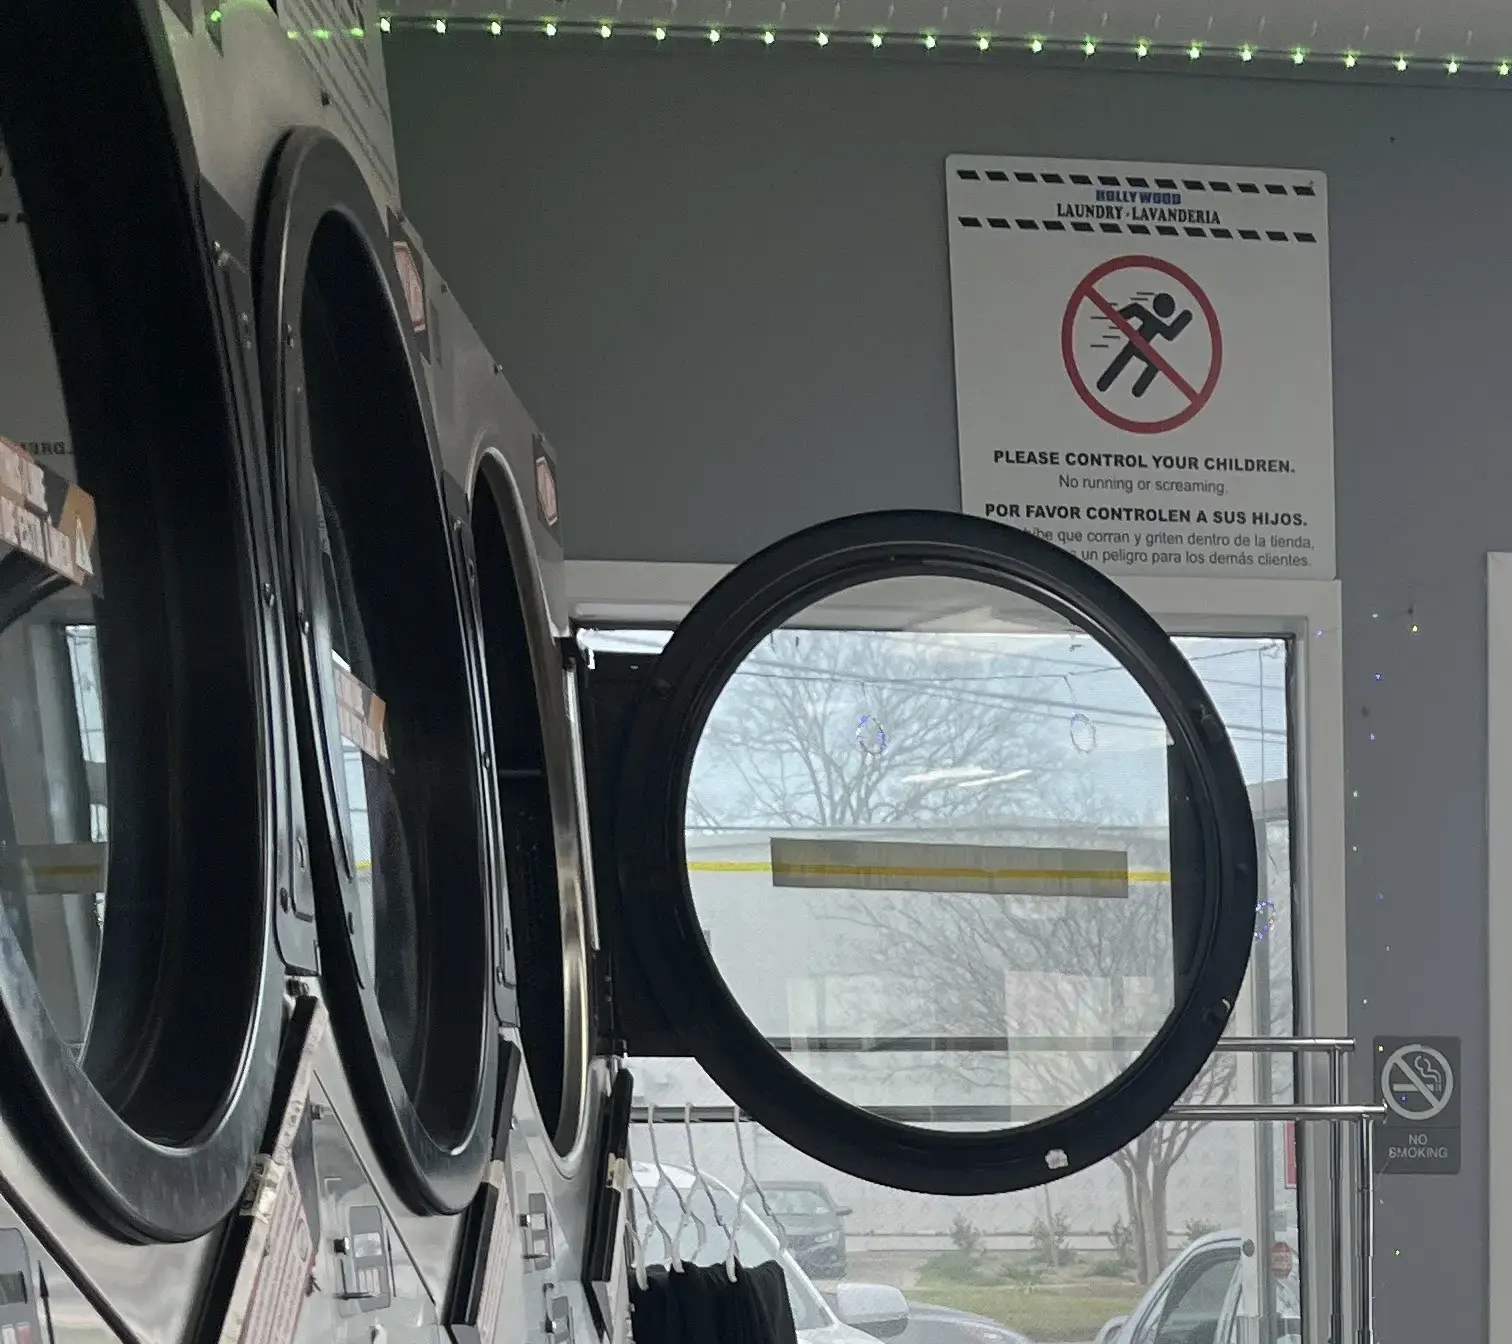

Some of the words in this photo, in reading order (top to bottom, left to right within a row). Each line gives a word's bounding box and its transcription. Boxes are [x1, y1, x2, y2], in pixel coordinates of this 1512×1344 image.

[1096, 190, 1182, 205] HOLLYWOOD
[1057, 203, 1123, 219] LAUNDRY
[1132, 208, 1221, 224] LAVANDERIA
[994, 450, 1059, 466] PLEASE
[1065, 452, 1148, 469] CONTROL
[1152, 455, 1199, 470] YOUR
[1204, 457, 1296, 474] CHILDREN.
[1059, 474, 1079, 488] No
[1083, 477, 1133, 493] running
[1137, 479, 1151, 491] or
[984, 503, 1021, 518] POR
[1026, 504, 1081, 520] FAVOR
[1086, 507, 1191, 523] CONTROLEN
[1196, 510, 1208, 523] A
[1212, 511, 1247, 525] SUS
[1252, 512, 1308, 527] HIJOS.
[1057, 530, 1083, 547] que
[1087, 531, 1130, 544] corran
[1133, 533, 1142, 546] y
[1146, 532, 1184, 547] griten
[1188, 532, 1230, 546] dentro
[1234, 533, 1251, 547] de
[1254, 534, 1266, 548] la
[1270, 535, 1315, 551] tienda,
[1082, 550, 1099, 562] un
[1102, 549, 1148, 565] peligro
[1151, 551, 1181, 564] para
[1185, 550, 1205, 564] los
[1209, 551, 1253, 565] demás
[1408, 1134, 1428, 1145] NO
[1389, 1147, 1448, 1159] SMOKING
